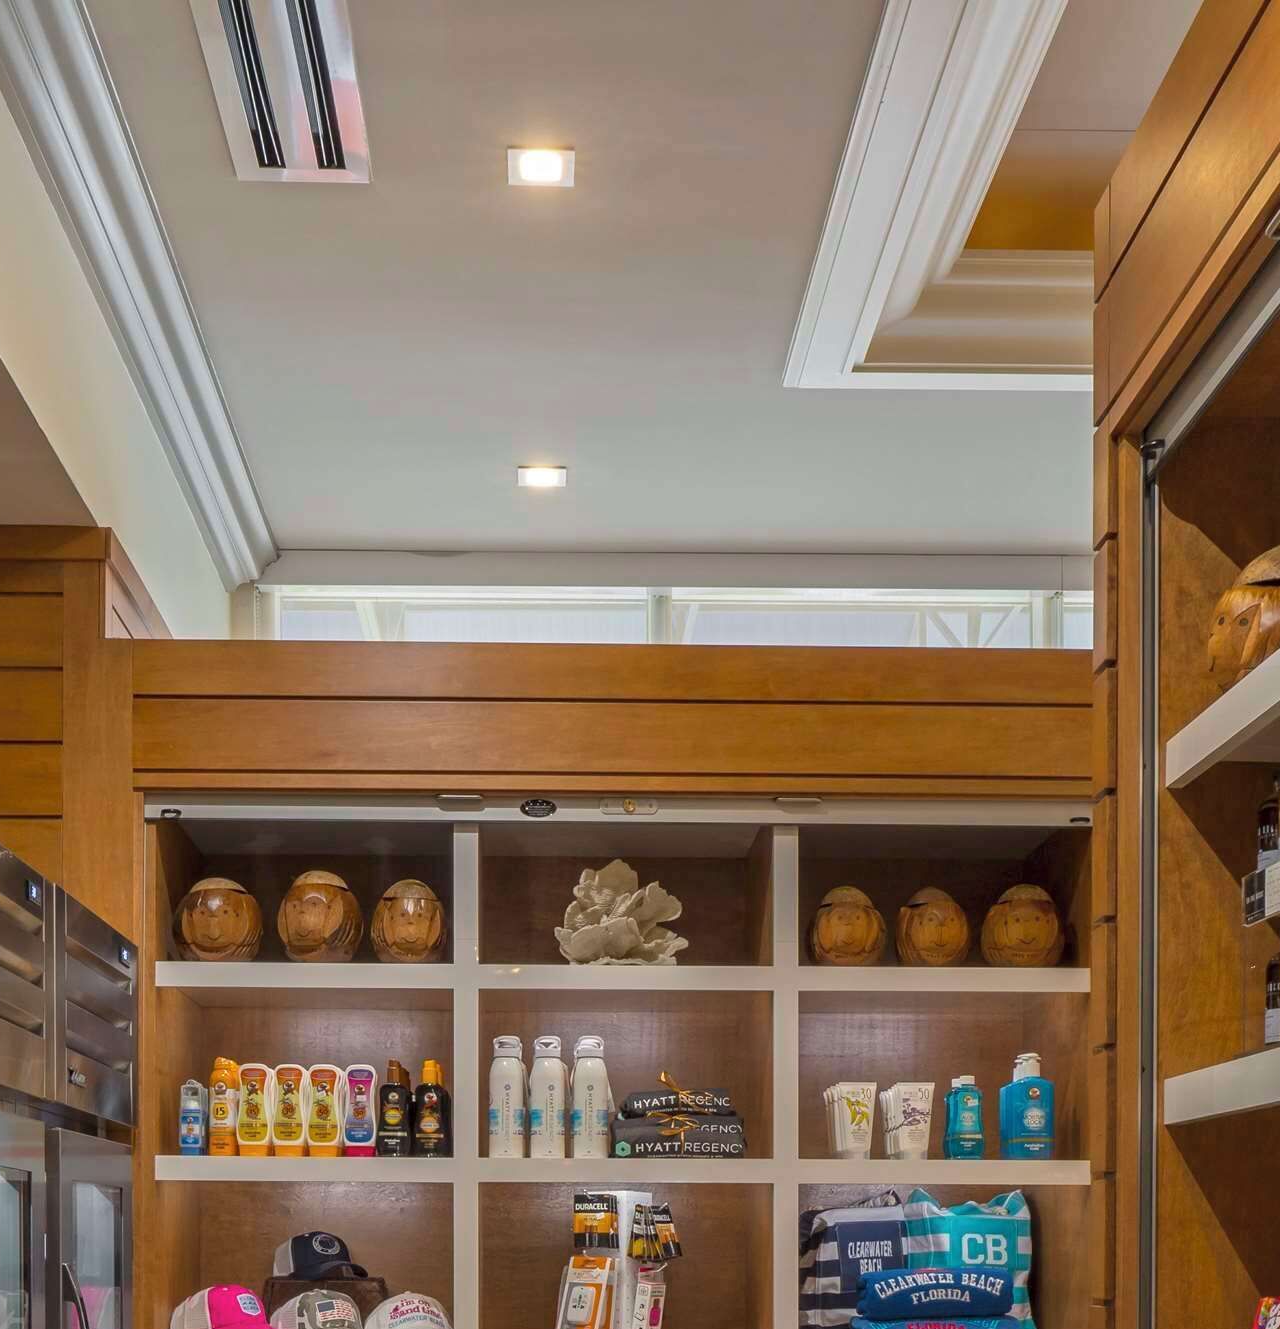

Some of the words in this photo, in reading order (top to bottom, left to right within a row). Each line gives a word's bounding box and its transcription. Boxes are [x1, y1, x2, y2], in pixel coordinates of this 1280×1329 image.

[633, 1095, 676, 1109] HYATT
[215, 1107, 225, 1116] 15
[635, 1141, 681, 1153] HYATT
[575, 1203, 609, 1211] DURACELL
[847, 1240, 894, 1259] CLEARWATER
[961, 1233, 1008, 1265] CB
[859, 1258, 882, 1275] BEACH
[874, 1273, 955, 1299] CLEARWATER
[961, 1273, 1005, 1296] BEACH
[911, 1288, 971, 1305] FLORIDA
